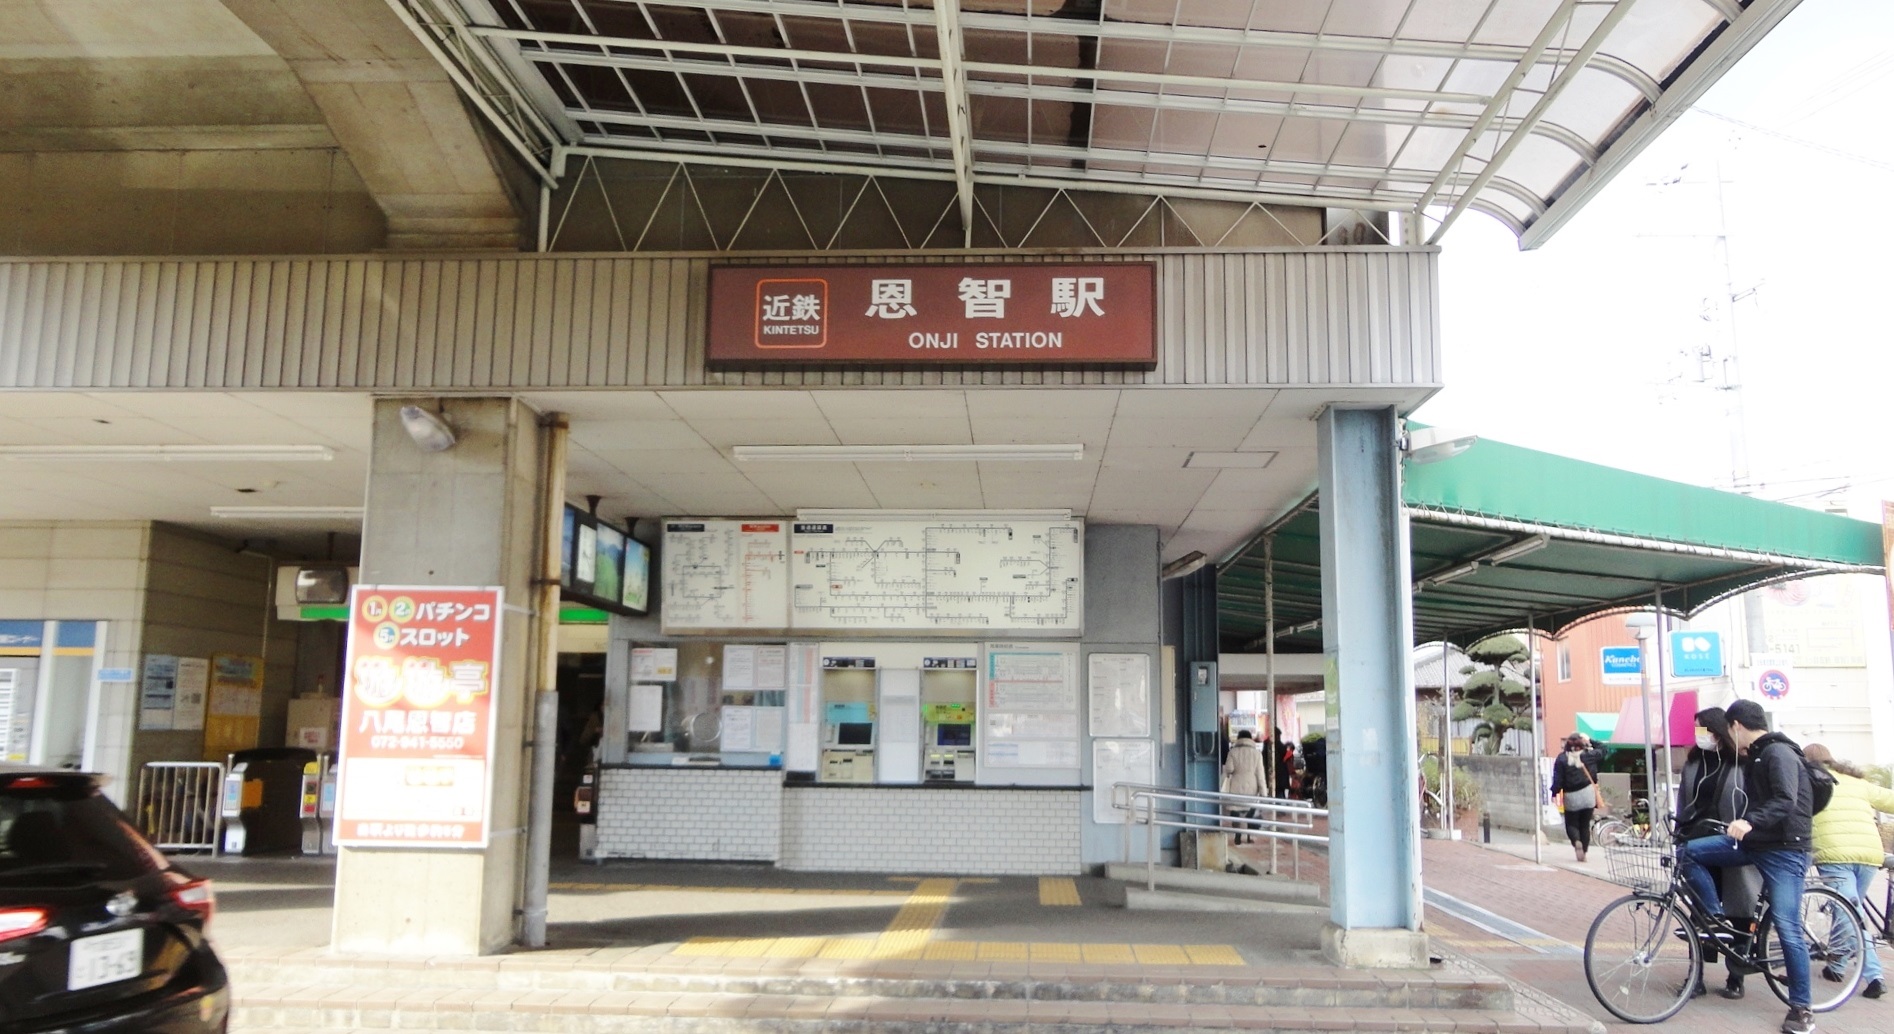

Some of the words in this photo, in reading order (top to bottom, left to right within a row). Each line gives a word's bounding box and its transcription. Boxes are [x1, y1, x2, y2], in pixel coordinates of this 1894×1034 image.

[762, 294, 820, 321] 近鉄
[865, 277, 1105, 319] 恩智駅
[763, 325, 820, 335] KINTETSU
[908, 332, 958, 349] ONJI
[975, 332, 1063, 349] STATION
[416, 601, 491, 621] パチンコ
[400, 627, 470, 647] スロット
